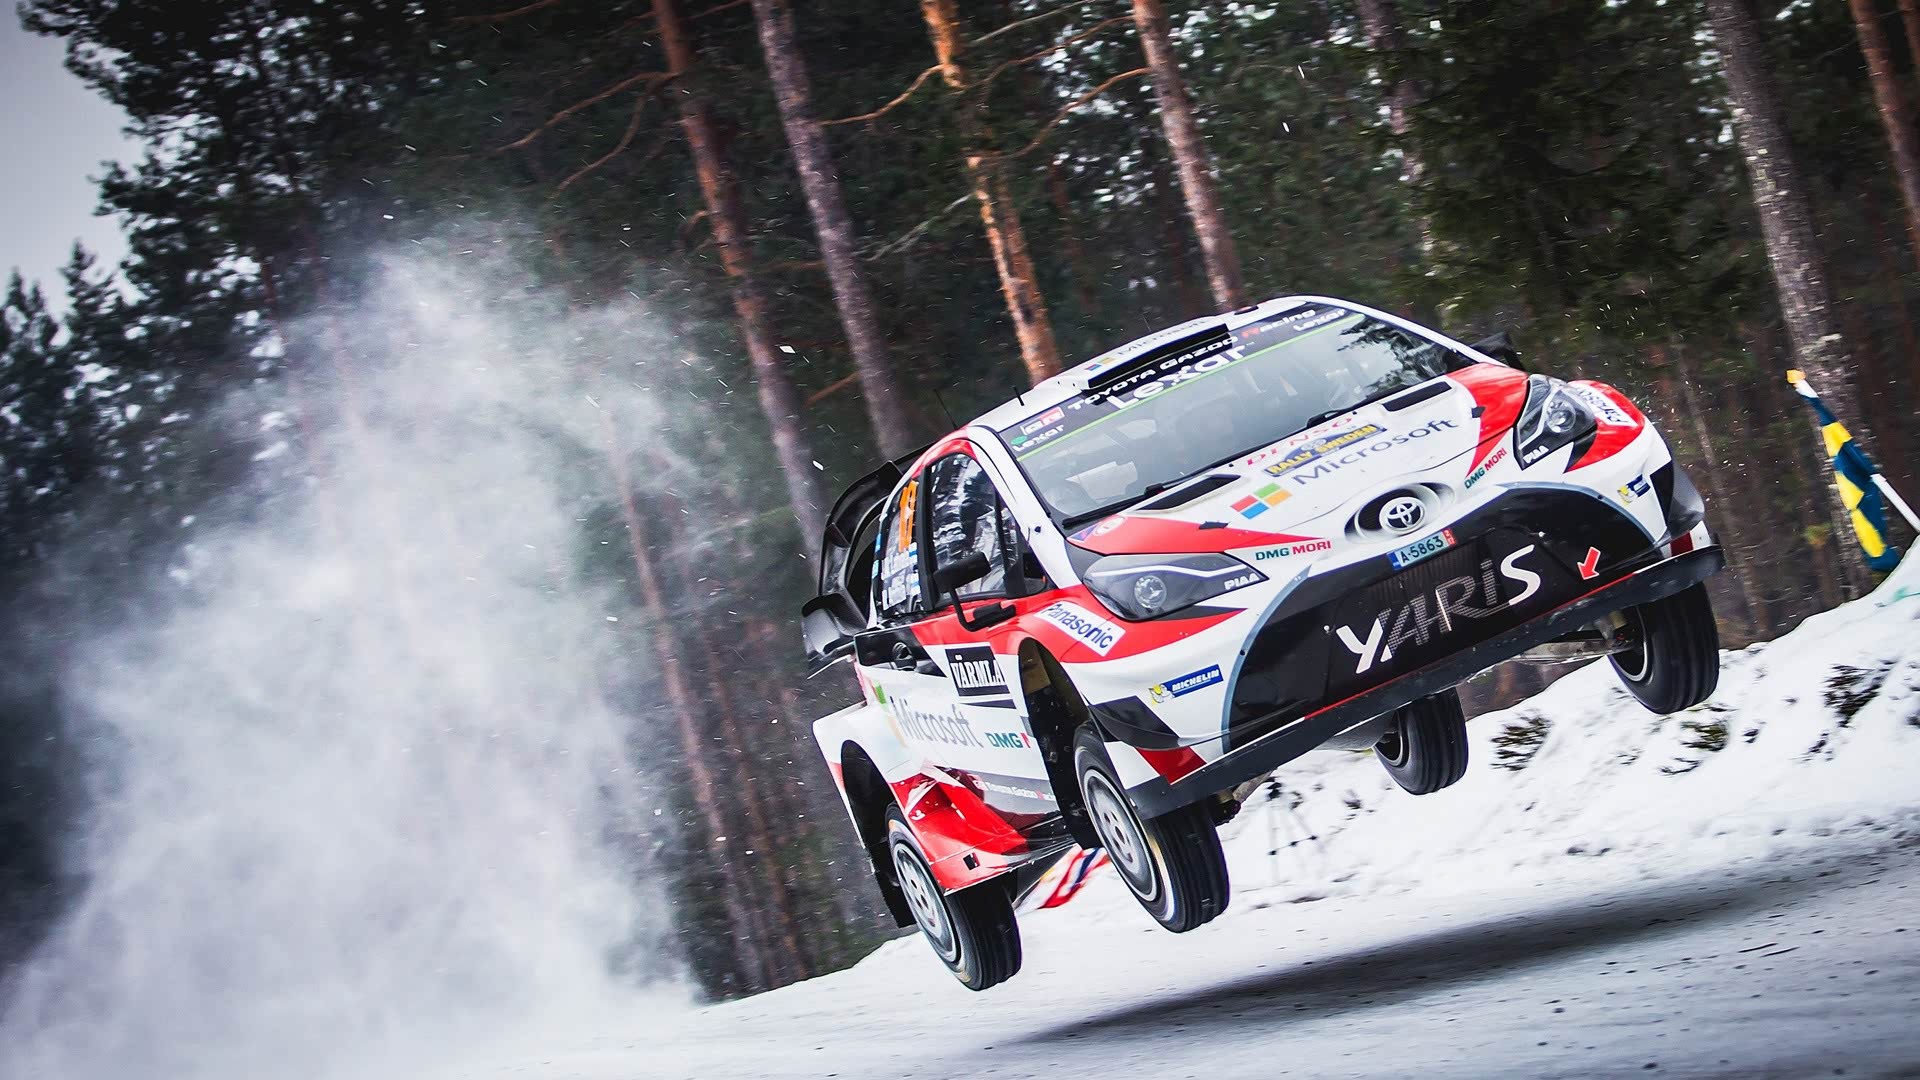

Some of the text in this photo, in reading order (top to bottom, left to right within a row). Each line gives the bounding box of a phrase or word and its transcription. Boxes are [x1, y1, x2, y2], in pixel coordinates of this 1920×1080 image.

[1067, 369, 1156, 411] TOYOTA
[1160, 336, 1239, 371] GAZOO
[1106, 344, 1245, 409] Lexar
[1012, 424, 1064, 452] Lexar
[1268, 451, 1313, 474] RALLY
[1316, 425, 1378, 454] SWEDEN
[1291, 419, 1459, 485] Microsoft
[1522, 445, 1549, 464] PIAA
[1464, 447, 1507, 490] DMG MORI
[1255, 540, 1332, 561] DMG MORI
[1223, 572, 1260, 591] PIAA
[1040, 604, 1113, 649] Panasonic
[1171, 668, 1219, 692] MICHELIN
[889, 695, 984, 749] Microsoft
[984, 732, 1024, 749] DMG
